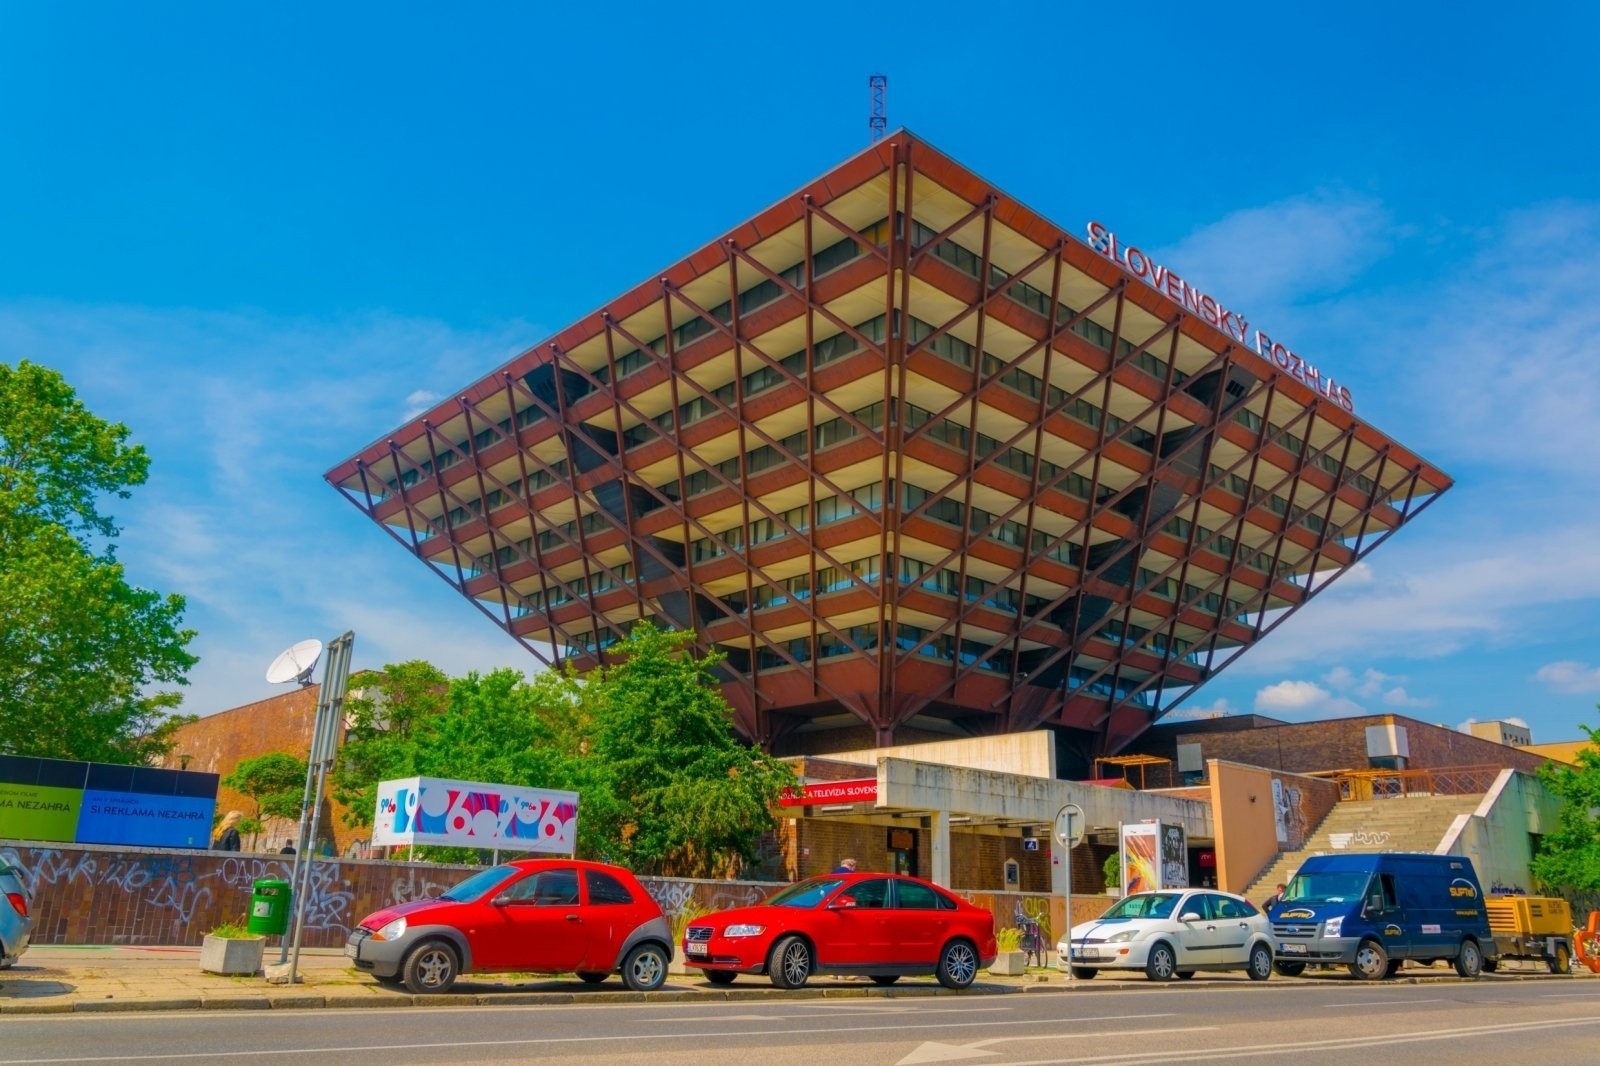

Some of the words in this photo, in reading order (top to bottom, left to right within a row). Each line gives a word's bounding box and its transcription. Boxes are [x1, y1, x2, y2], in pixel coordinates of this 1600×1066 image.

[1087, 221, 1248, 342] SLOVENSKÝ
[1255, 330, 1353, 412] ROZHLAS
[814, 789, 845, 798] TELEVÍZIA
[847, 785, 878, 796] SLOVENS
[17, 801, 71, 812] NEZAHRÁ
[90, 805, 101, 814] SI
[103, 806, 155, 818] REKLAMA
[157, 809, 205, 820] NEZAHRÁ
